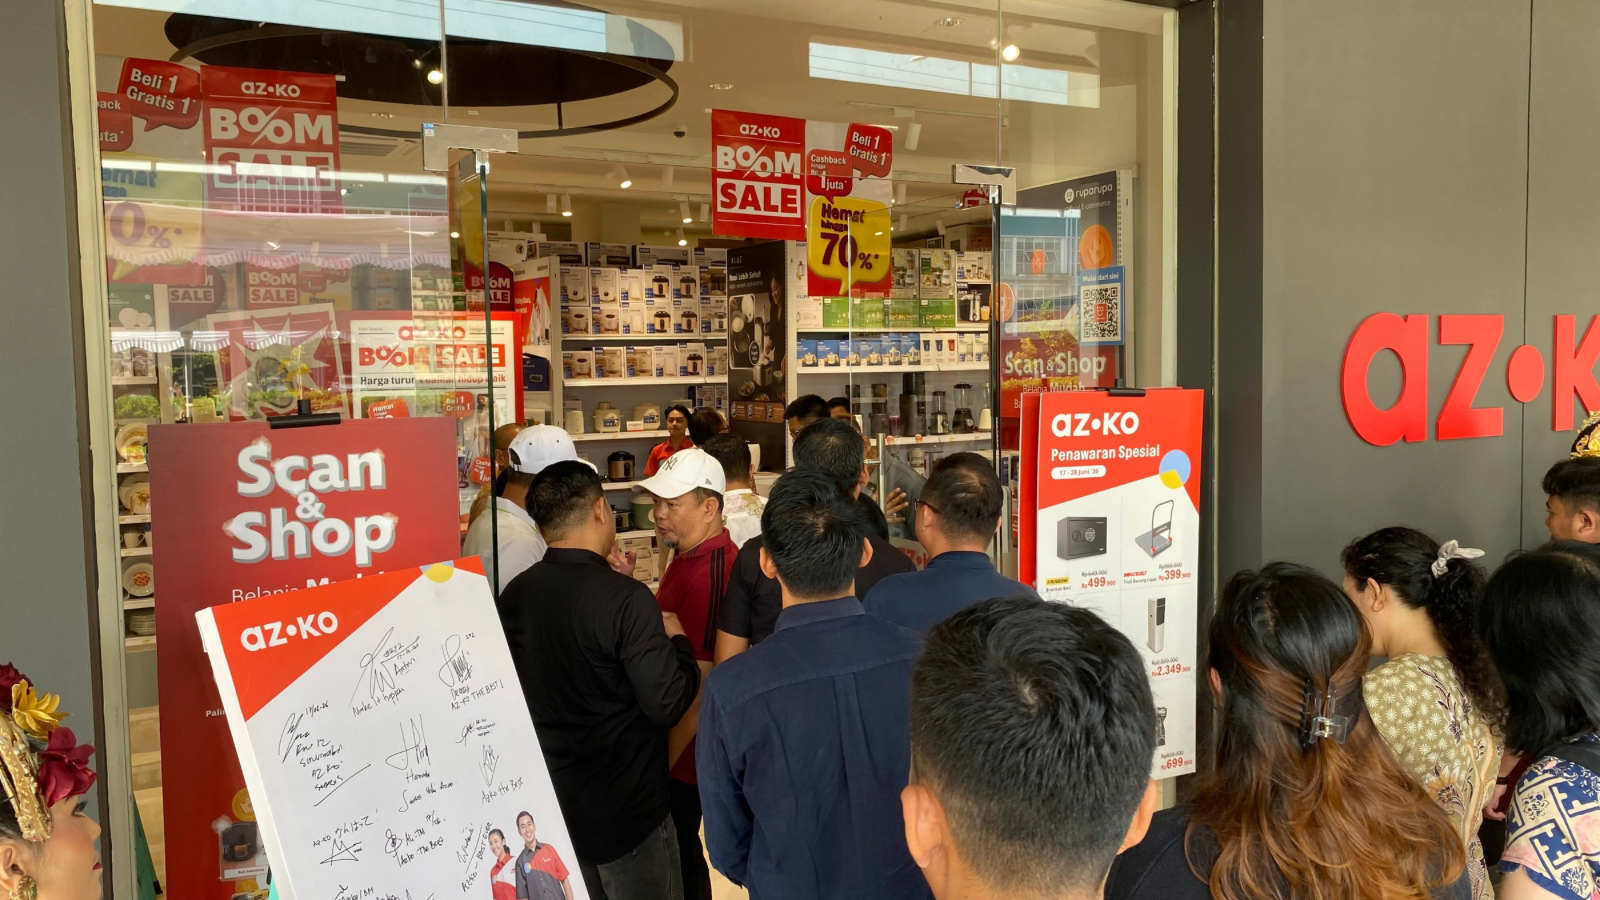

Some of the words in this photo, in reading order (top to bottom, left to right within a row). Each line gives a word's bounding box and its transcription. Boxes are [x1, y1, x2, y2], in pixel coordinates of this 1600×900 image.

[130, 68, 163, 88] Beli
[168, 75, 178, 93] 1
[126, 85, 175, 110] Gratis
[852, 132, 872, 147] Beli
[874, 136, 881, 149] 1
[811, 154, 847, 165] Cashback
[849, 145, 878, 163] Gratis
[217, 151, 331, 187] SALE
[720, 182, 798, 214] SALE
[1075, 184, 1113, 199] ruparupa
[1081, 200, 1111, 210] E-commerce
[821, 203, 866, 224] Hemat
[471, 276, 511, 289] BOM
[729, 273, 738, 281] Nasi
[738, 272, 749, 280] Lebih
[749, 271, 762, 279] Sehat
[1082, 274, 1097, 282] Mulai
[1098, 273, 1109, 281] dari
[1109, 271, 1119, 280] sini
[170, 289, 213, 302] SALE
[251, 289, 296, 302] SALE
[441, 346, 500, 365] SALE
[1004, 351, 1044, 376] Scan
[1046, 359, 1054, 371] &
[1055, 351, 1107, 380] Shop
[360, 376, 389, 386] Harga
[458, 374, 484, 386] hidup
[372, 404, 394, 413] Hemat
[1051, 446, 1116, 462] Penawaran
[1118, 444, 1160, 461] Spesial
[236, 440, 388, 497] Scan
[1078, 468, 1089, 477] Juni
[295, 491, 325, 521] &
[231, 507, 396, 567] Shop
[471, 687, 485, 700] THE
[352, 702, 372, 717] Make
